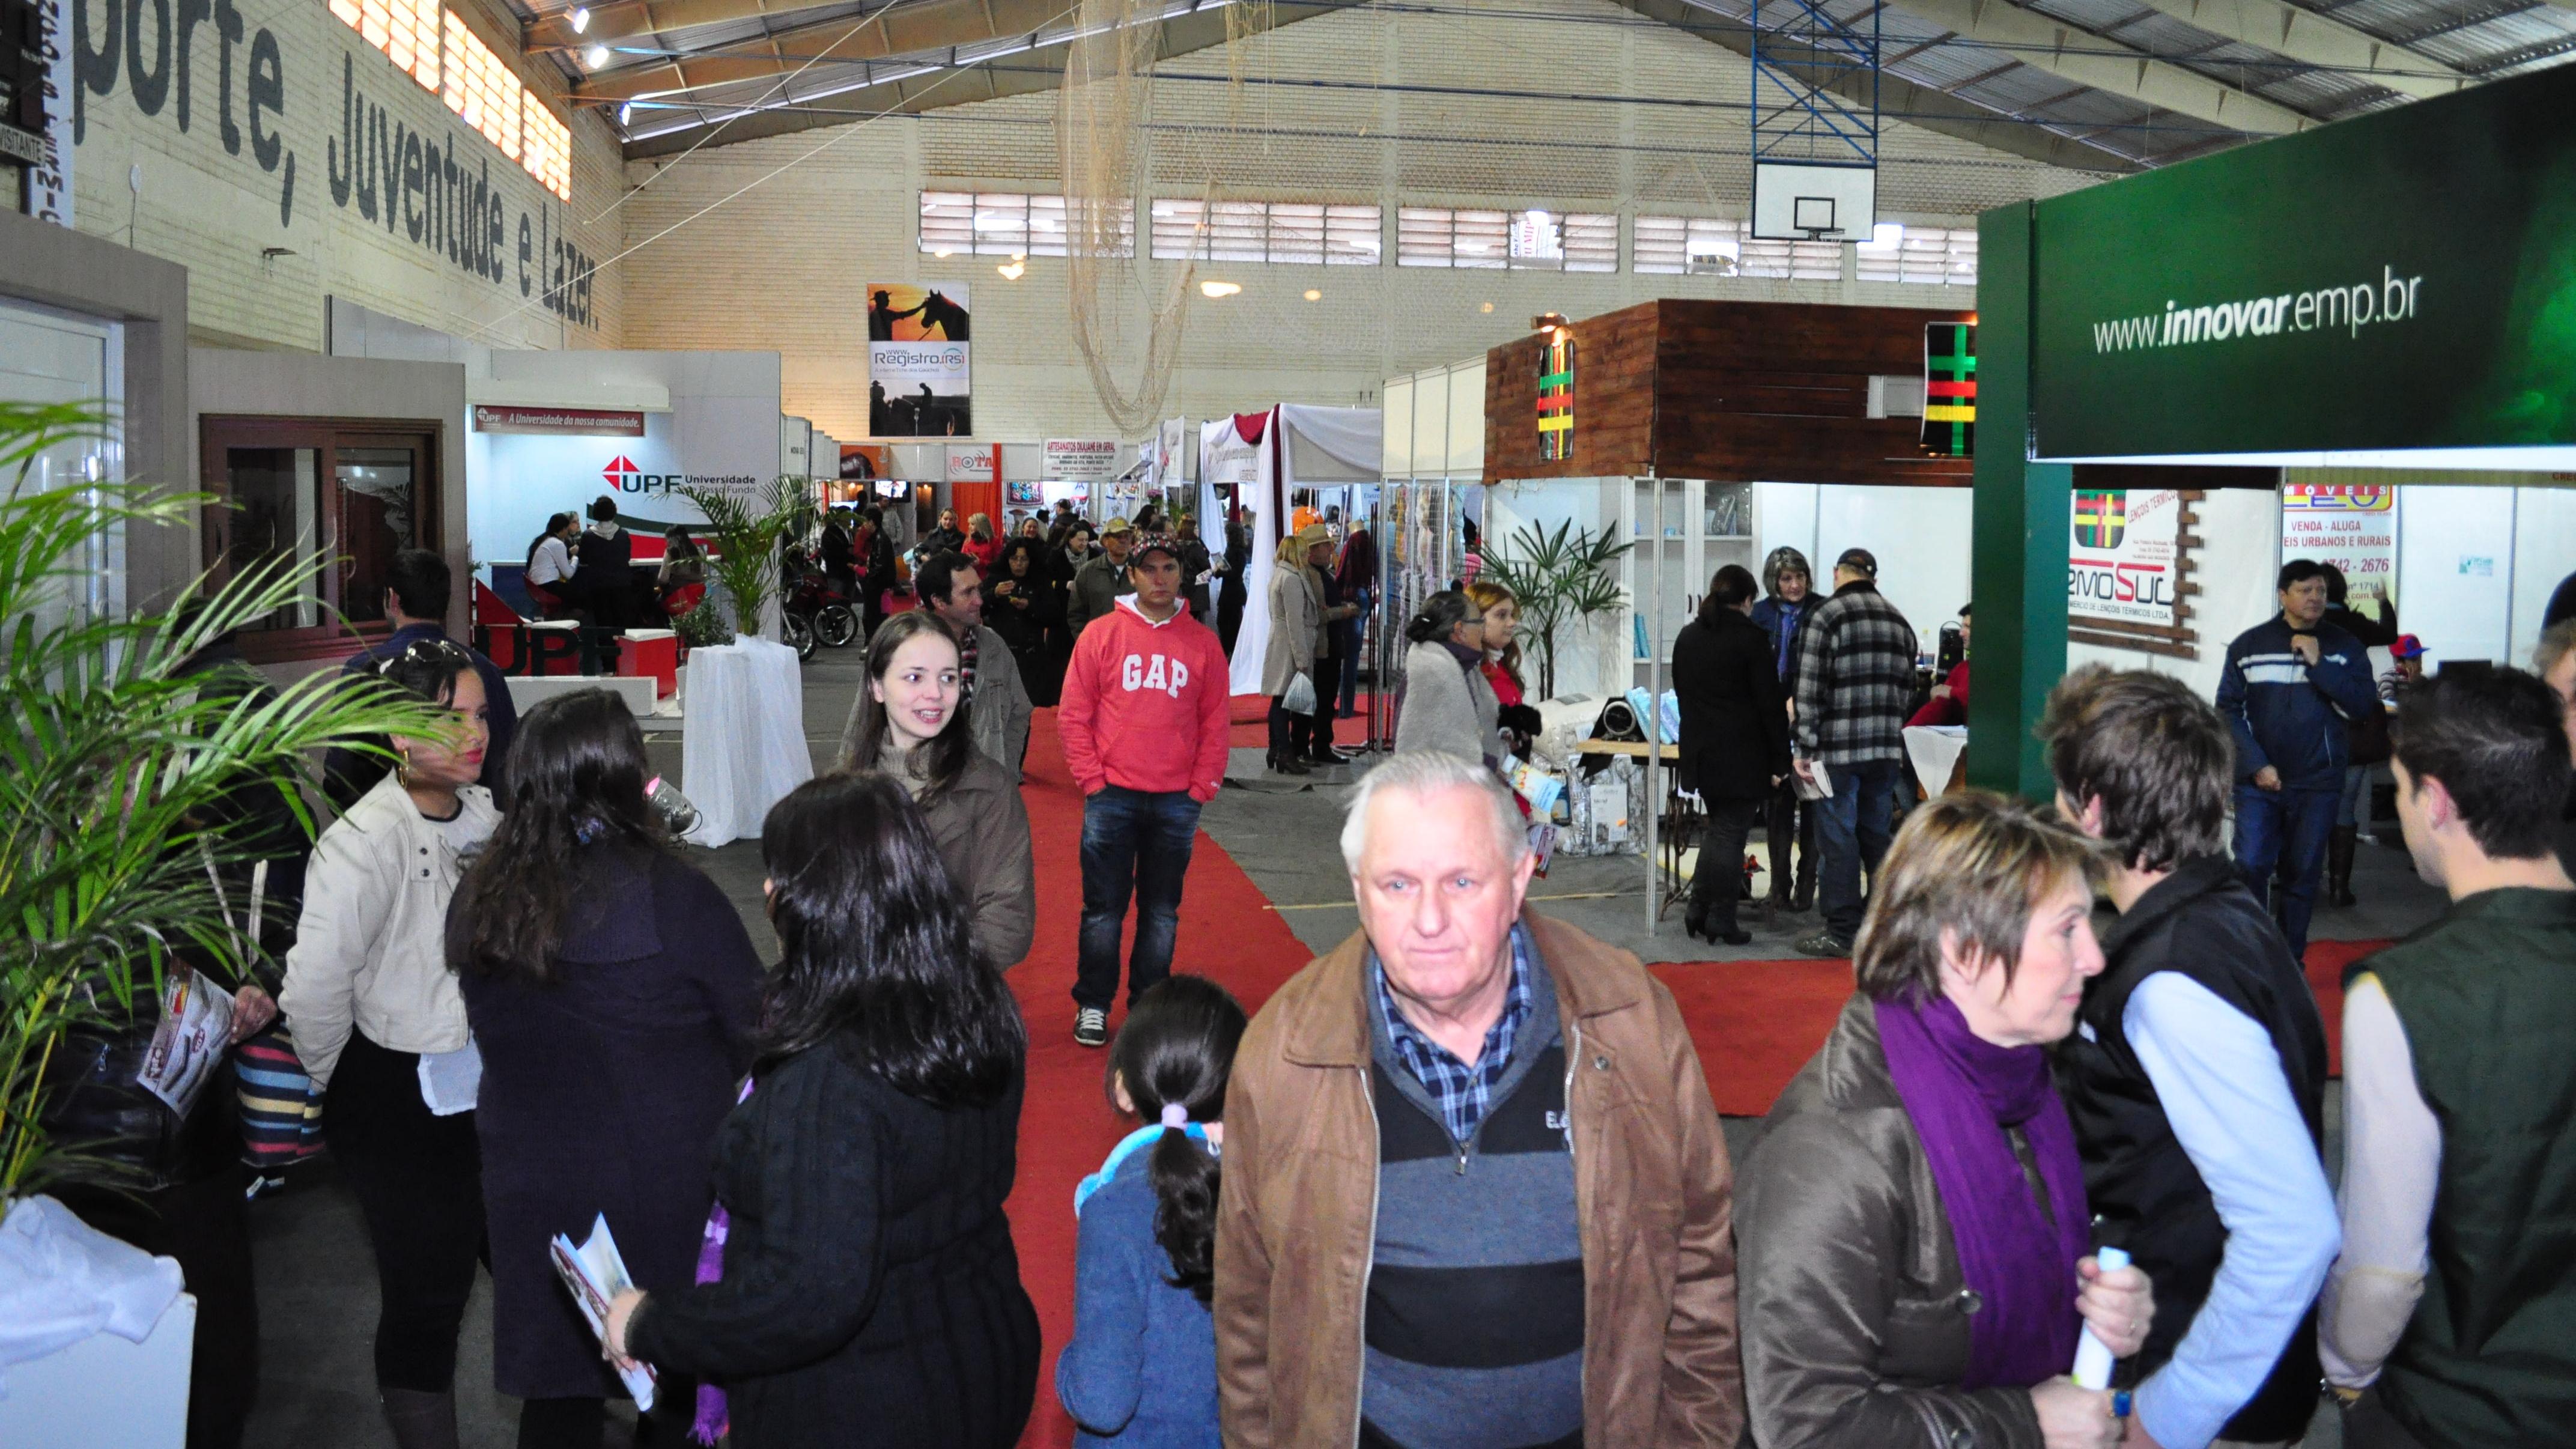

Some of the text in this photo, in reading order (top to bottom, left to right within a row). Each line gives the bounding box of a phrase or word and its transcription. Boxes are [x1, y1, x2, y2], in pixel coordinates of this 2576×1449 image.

[328, 51, 504, 285] Juventude
[518, 212, 532, 297] e
[542, 201, 598, 332] Lazer.
[2094, 264, 2422, 354] www.innovar.emp.br
[482, 413, 640, 428] UPF A Universidade da nossa comunidade.
[622, 474, 756, 493] UPF Universidade
[727, 486, 756, 494] Fundo
[2291, 521, 2322, 532] VENDA
[2330, 520, 2362, 532] ALUGA
[2301, 536, 2346, 547] URBANOS
[2350, 536, 2354, 547] E
[2357, 536, 2391, 547] RURAIS
[2361, 557, 2389, 573] 2676
[2152, 610, 2170, 619] LTDA.
[475, 627, 626, 677] UPF
[1122, 654, 1188, 698] GAP
